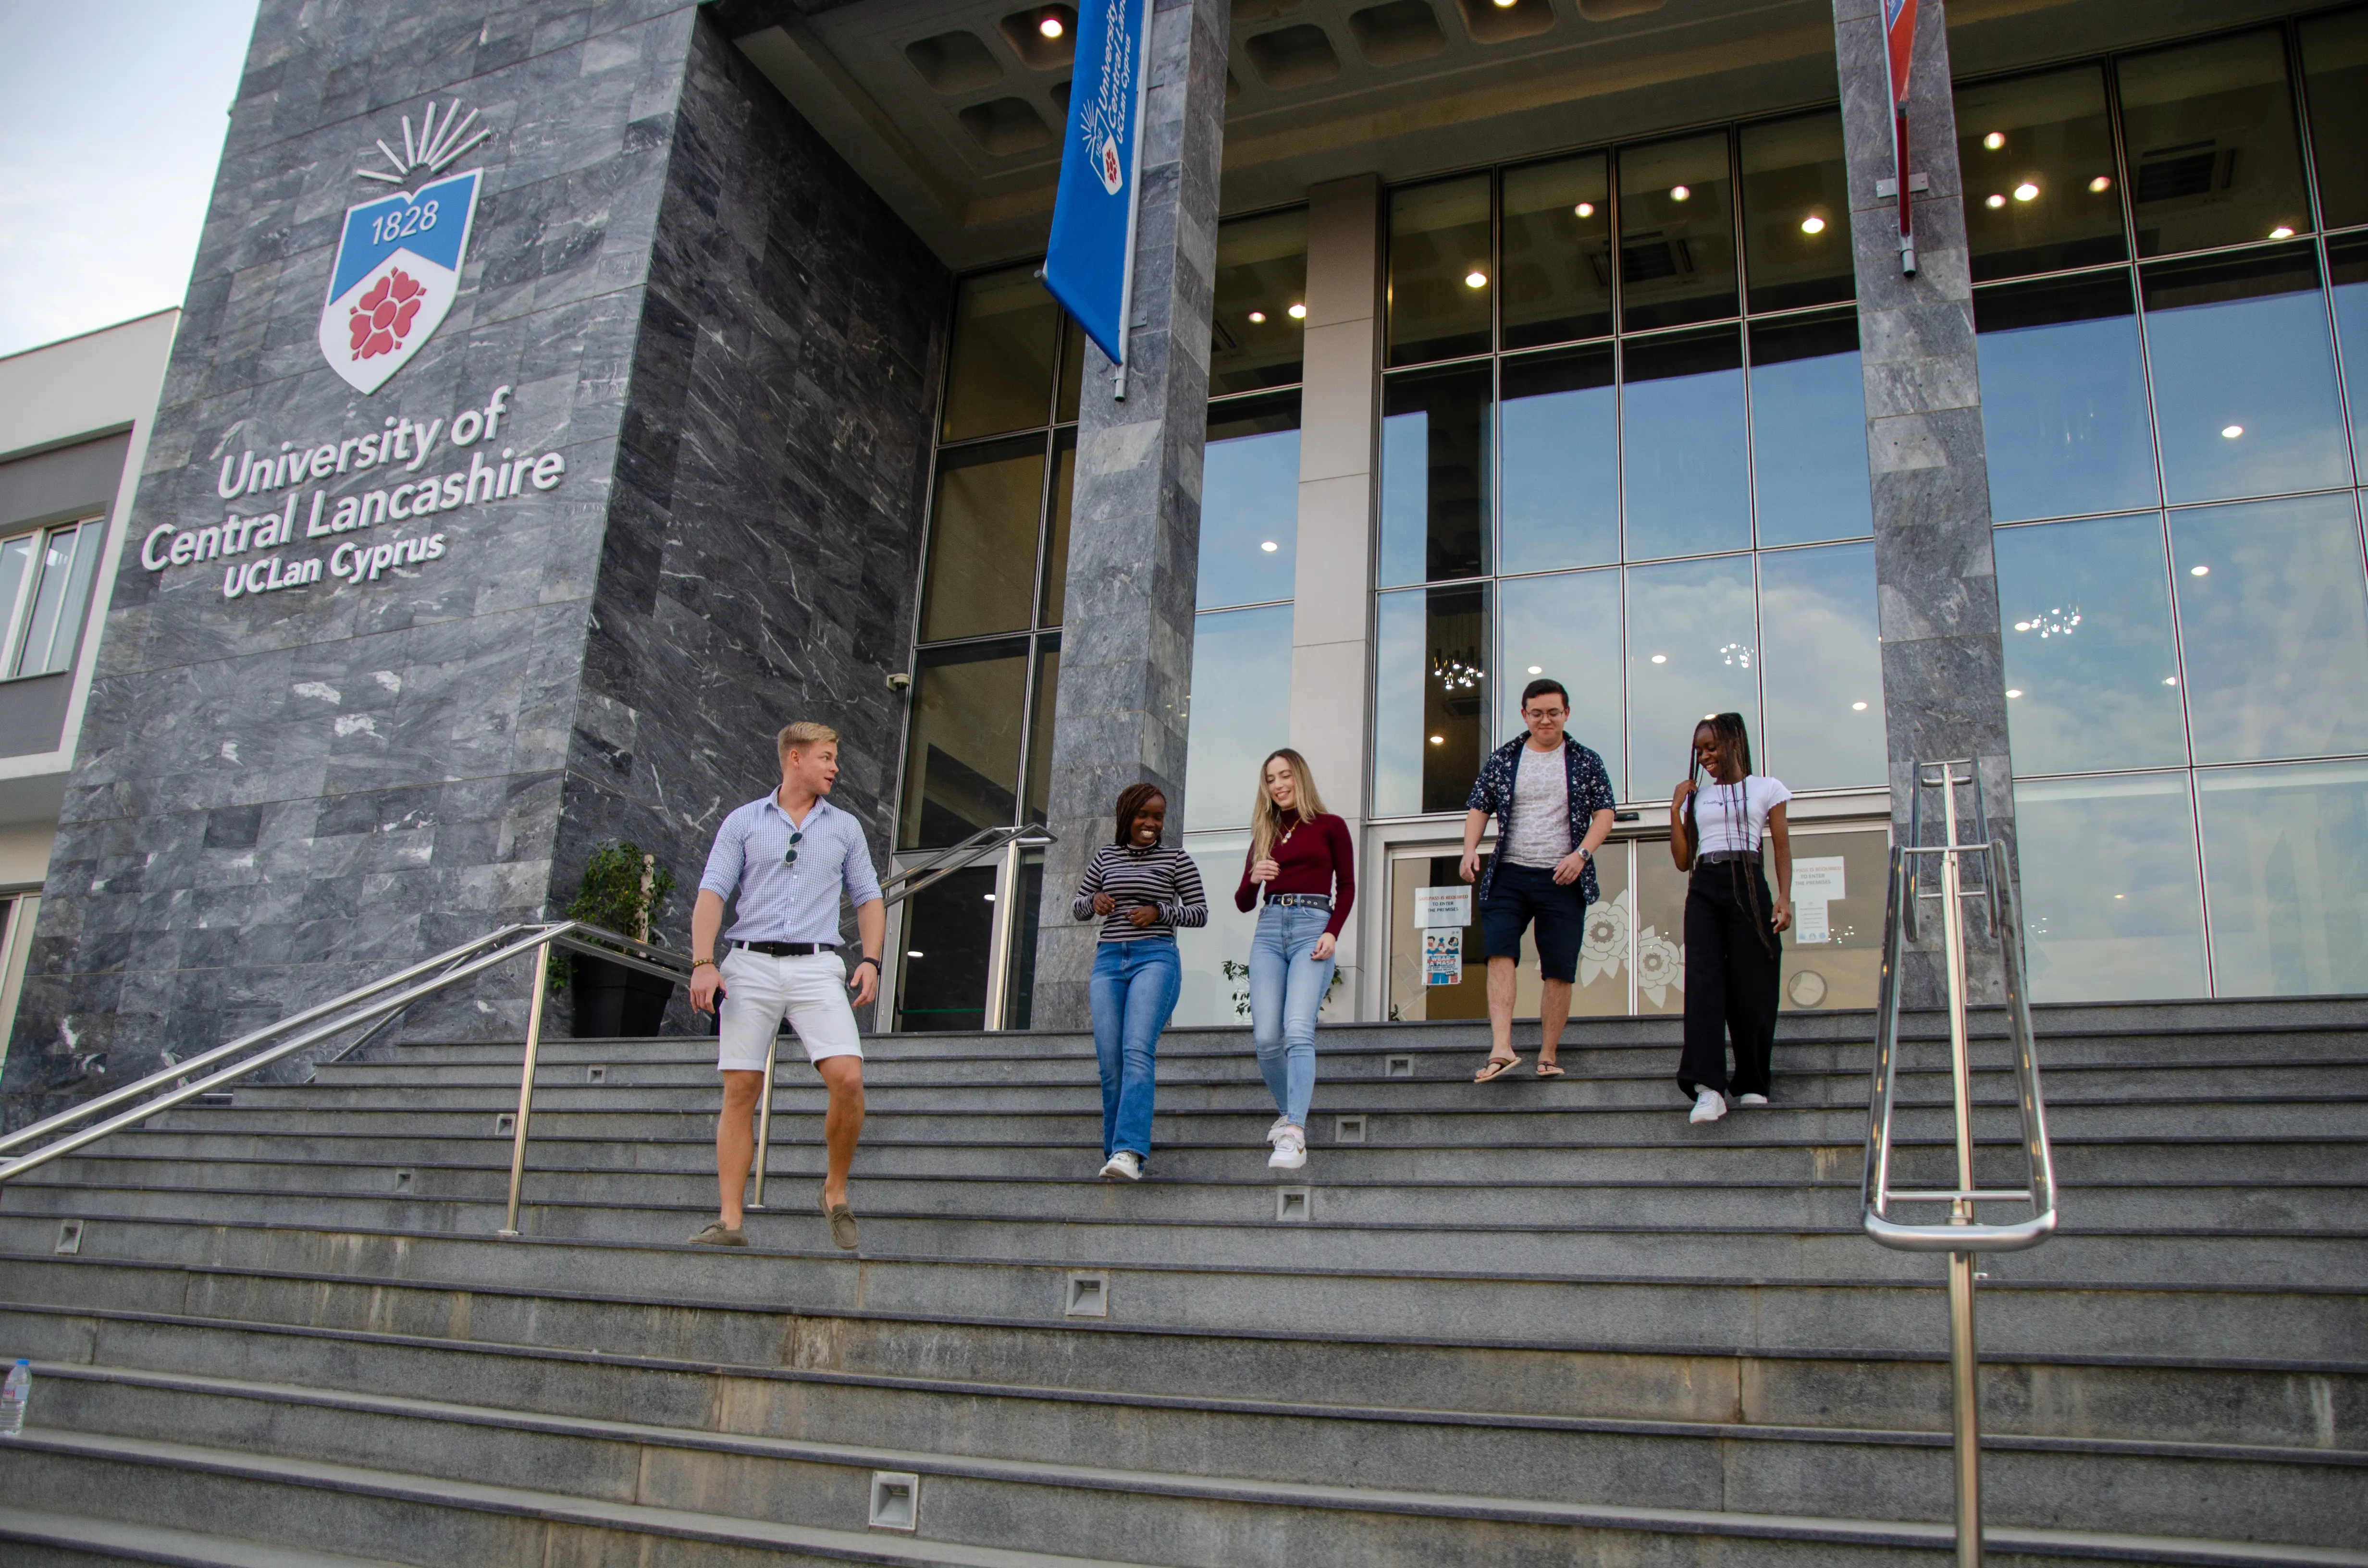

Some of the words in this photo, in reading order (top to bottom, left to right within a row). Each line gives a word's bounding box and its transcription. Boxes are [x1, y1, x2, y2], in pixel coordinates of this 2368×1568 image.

[1098, 0, 1117, 111] University
[1109, 39, 1122, 129] Central
[1116, 91, 1126, 144] UCLan
[1121, 33, 1131, 89] Cyprus
[371, 200, 439, 245] 1828
[218, 416, 443, 500] University
[450, 385, 511, 447] of
[141, 493, 298, 572] Central
[306, 447, 566, 539] Lancashire
[222, 556, 321, 599] UCLan
[330, 532, 446, 584] Cyprus
